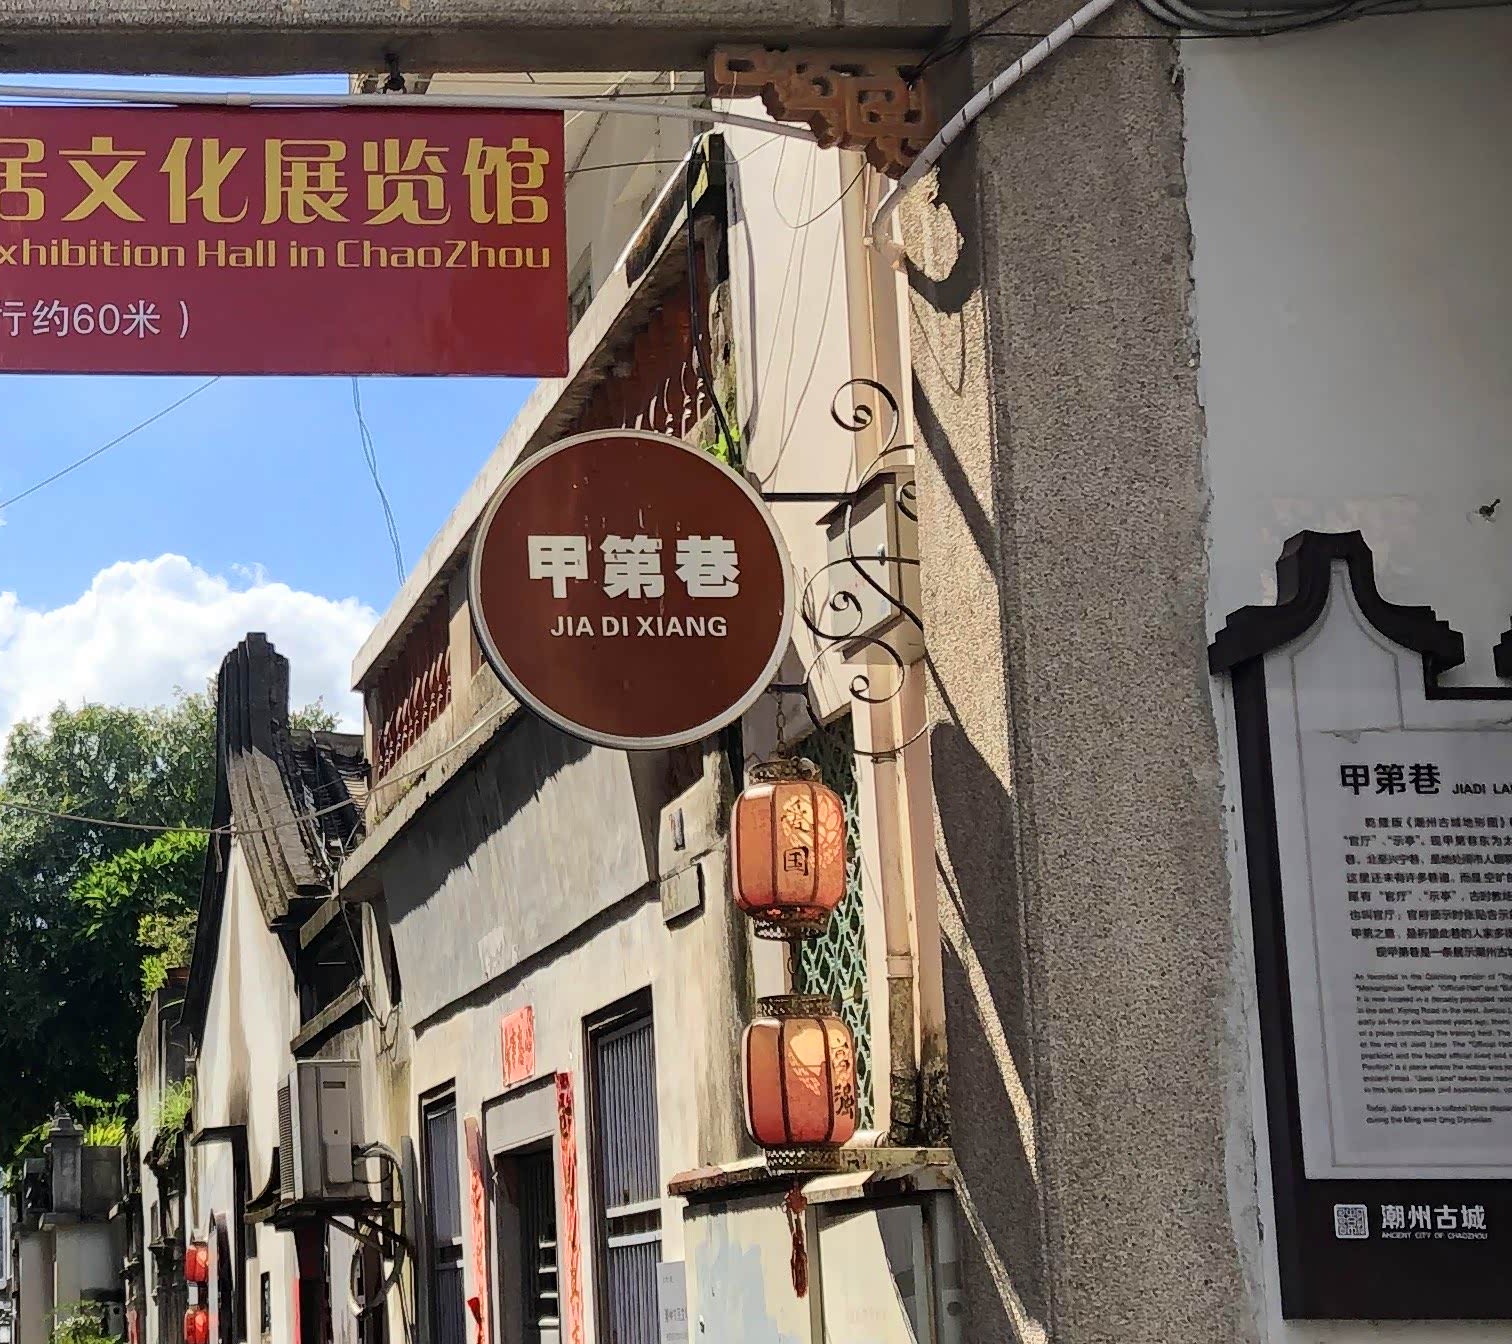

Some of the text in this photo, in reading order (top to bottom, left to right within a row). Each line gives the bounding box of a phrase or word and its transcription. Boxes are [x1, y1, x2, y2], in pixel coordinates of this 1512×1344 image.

[197, 239, 276, 268] Hall
[289, 239, 325, 268] in
[337, 240, 550, 268] ChaoZhou
[527, 534, 740, 600] 甲第巷
[550, 616, 728, 638] JIA DI XIANG
[1340, 763, 1441, 795] 甲第巷
[1452, 783, 1486, 795] JIADI
[780, 799, 810, 877] 爱国
[1380, 1204, 1487, 1230] 潮州古城
